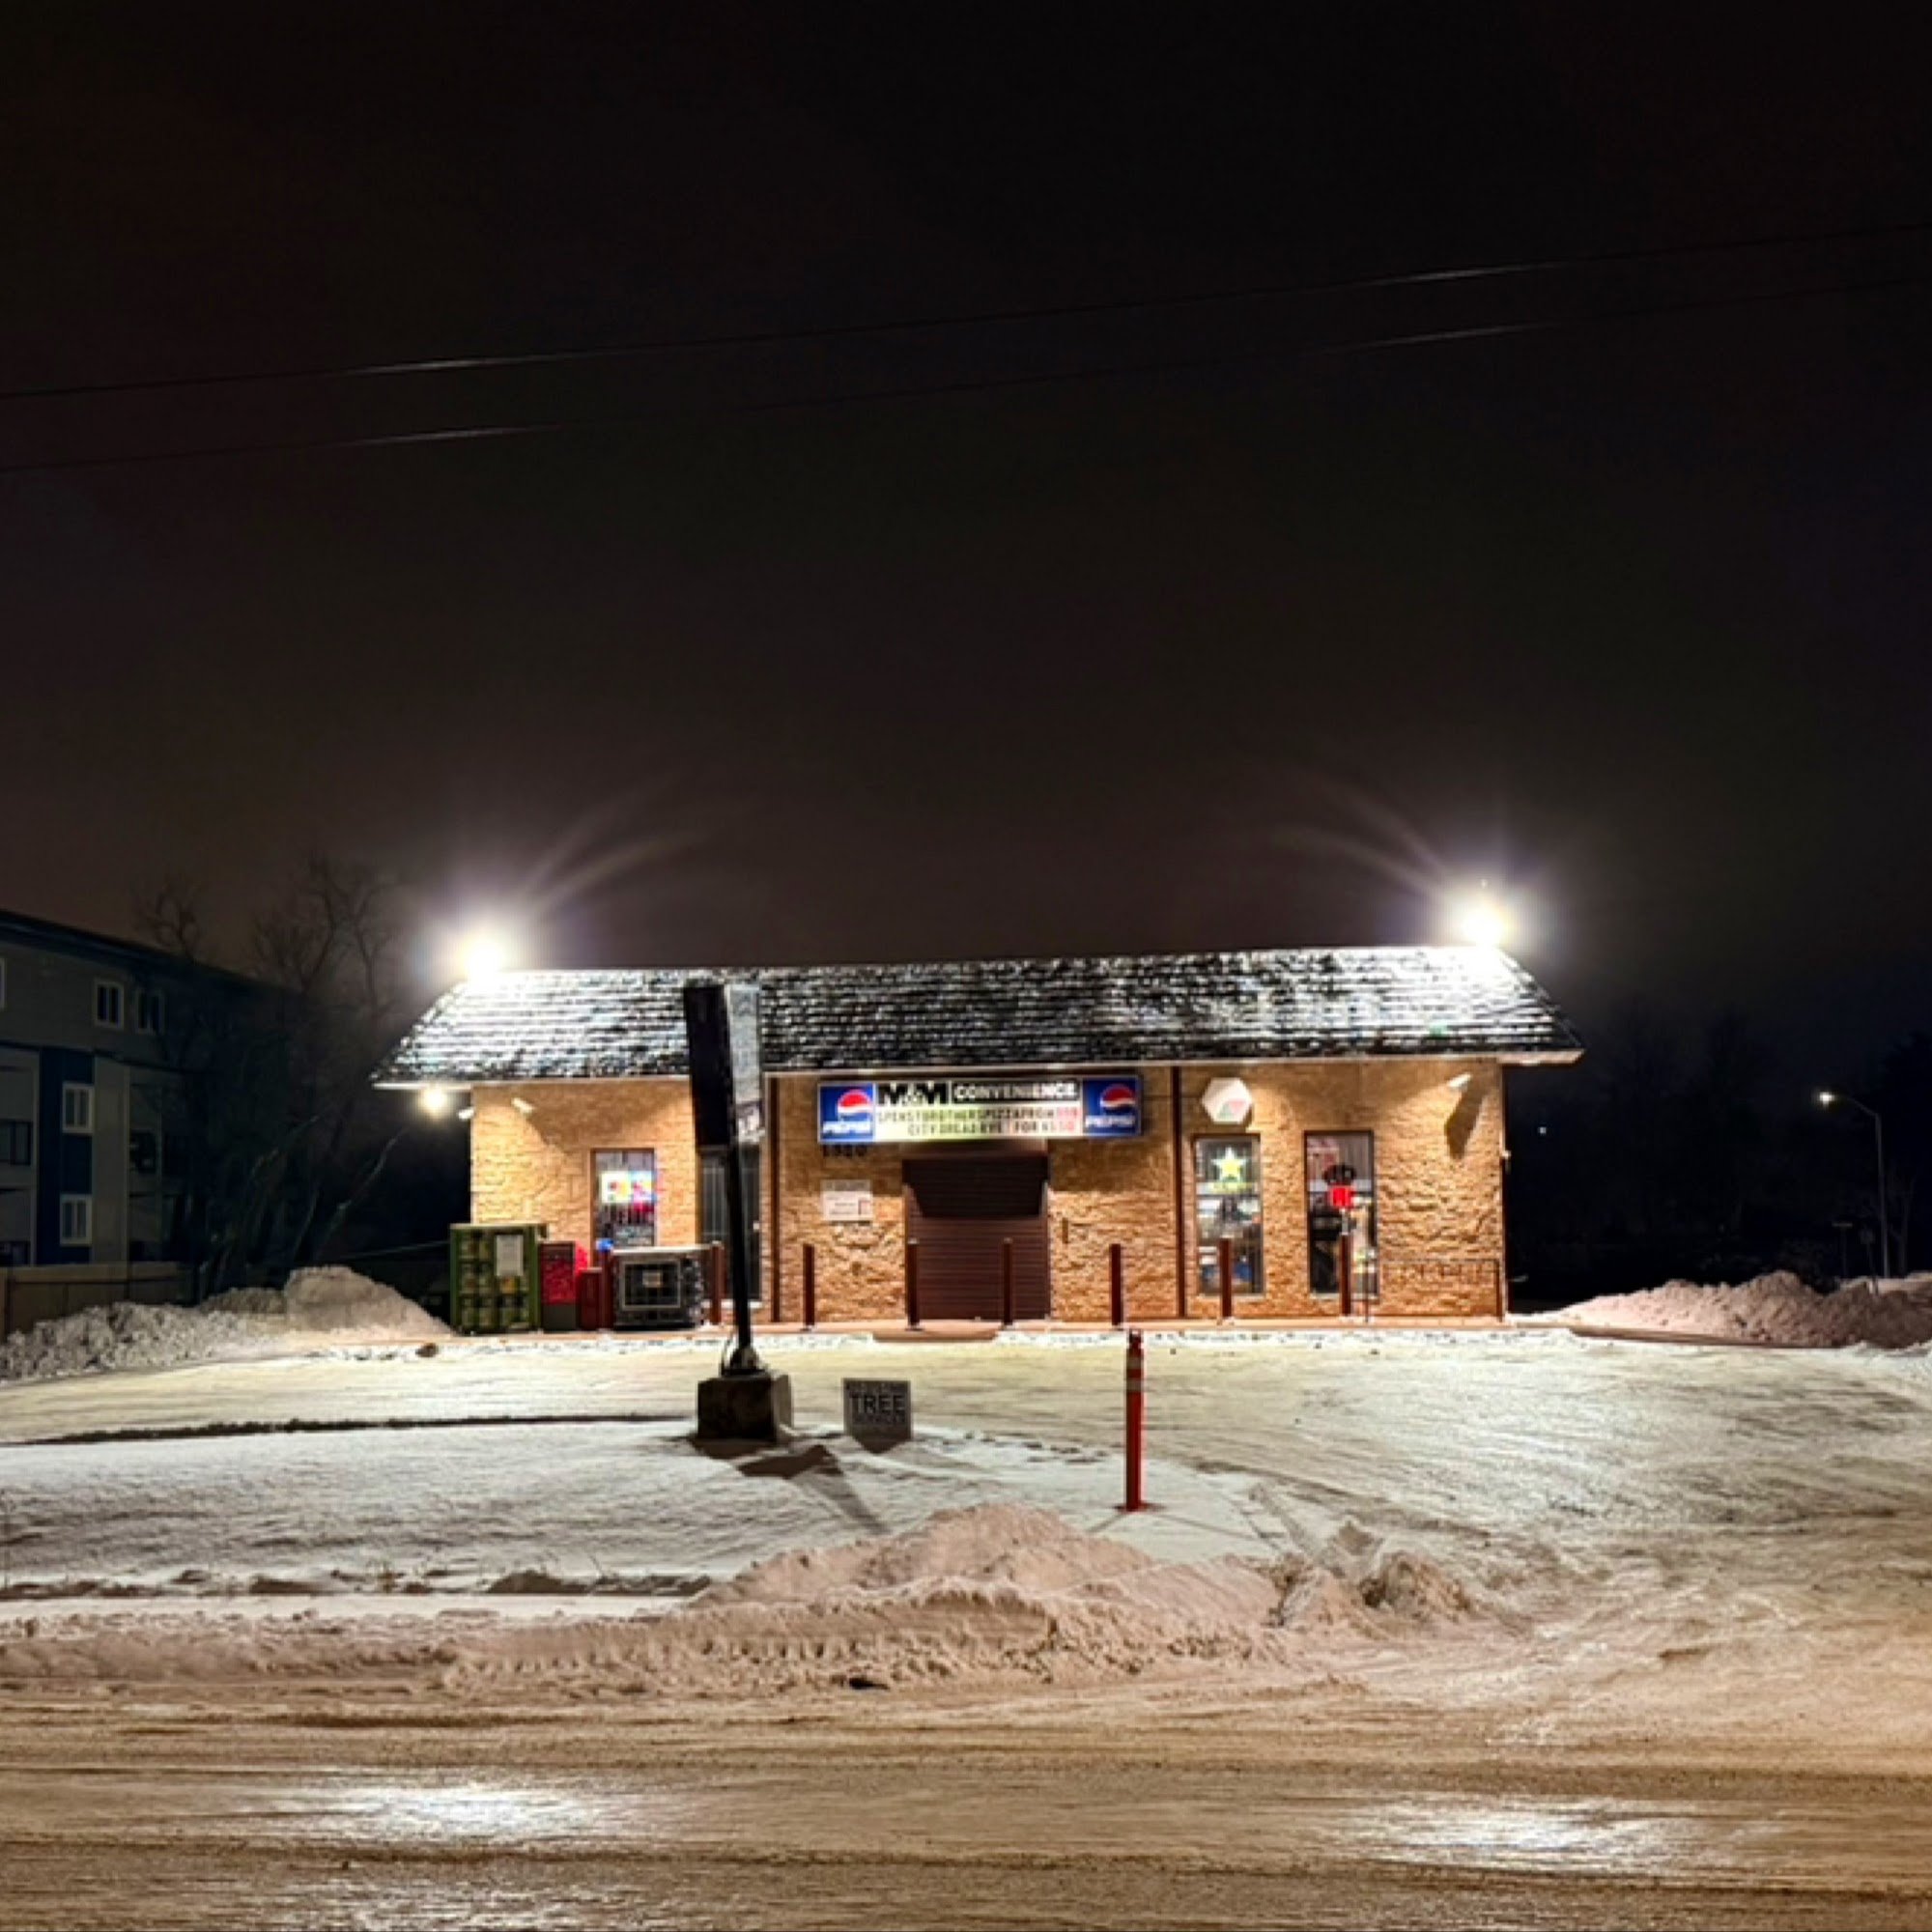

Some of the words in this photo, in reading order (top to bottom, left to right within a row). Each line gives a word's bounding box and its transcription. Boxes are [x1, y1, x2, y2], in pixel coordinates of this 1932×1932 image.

[877, 1082, 948, 1106] M&M
[954, 1082, 1077, 1099] CONVENIENCE
[849, 1393, 906, 1414] TREE
